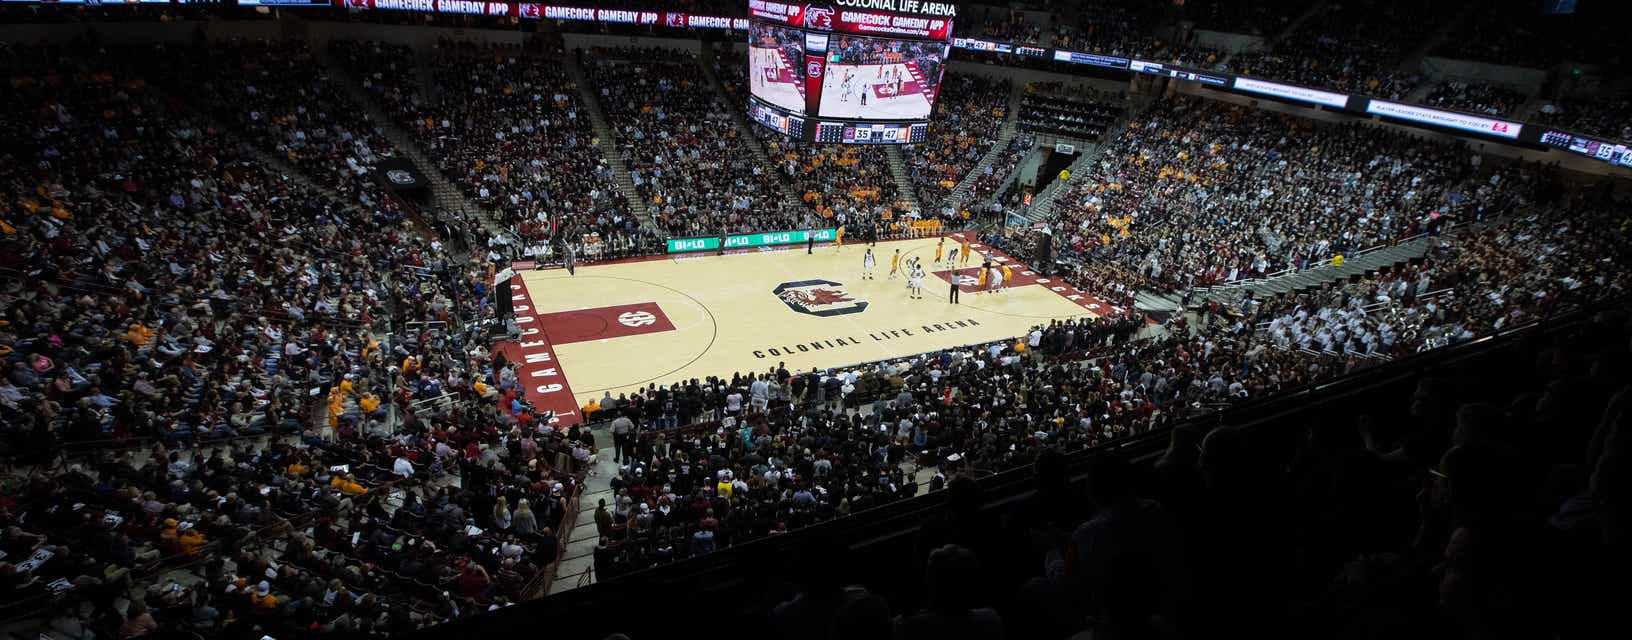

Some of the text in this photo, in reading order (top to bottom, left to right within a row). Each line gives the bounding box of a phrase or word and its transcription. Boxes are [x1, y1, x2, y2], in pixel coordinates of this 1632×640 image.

[438, 0, 485, 14] GAMEDAY
[488, 3, 508, 16] APP
[545, 6, 658, 24] GAMECOCK GAMEDAY APP
[899, 0, 920, 13] LIFE
[921, 2, 956, 16] ARENA
[689, 15, 731, 28] GAMECOCK
[841, 11, 944, 30] GAMECOCK GAMEDAY APP
[857, 129, 868, 139] 35
[885, 130, 896, 138] 47
[752, 318, 982, 359] COLONIAL LIFE ARENA
